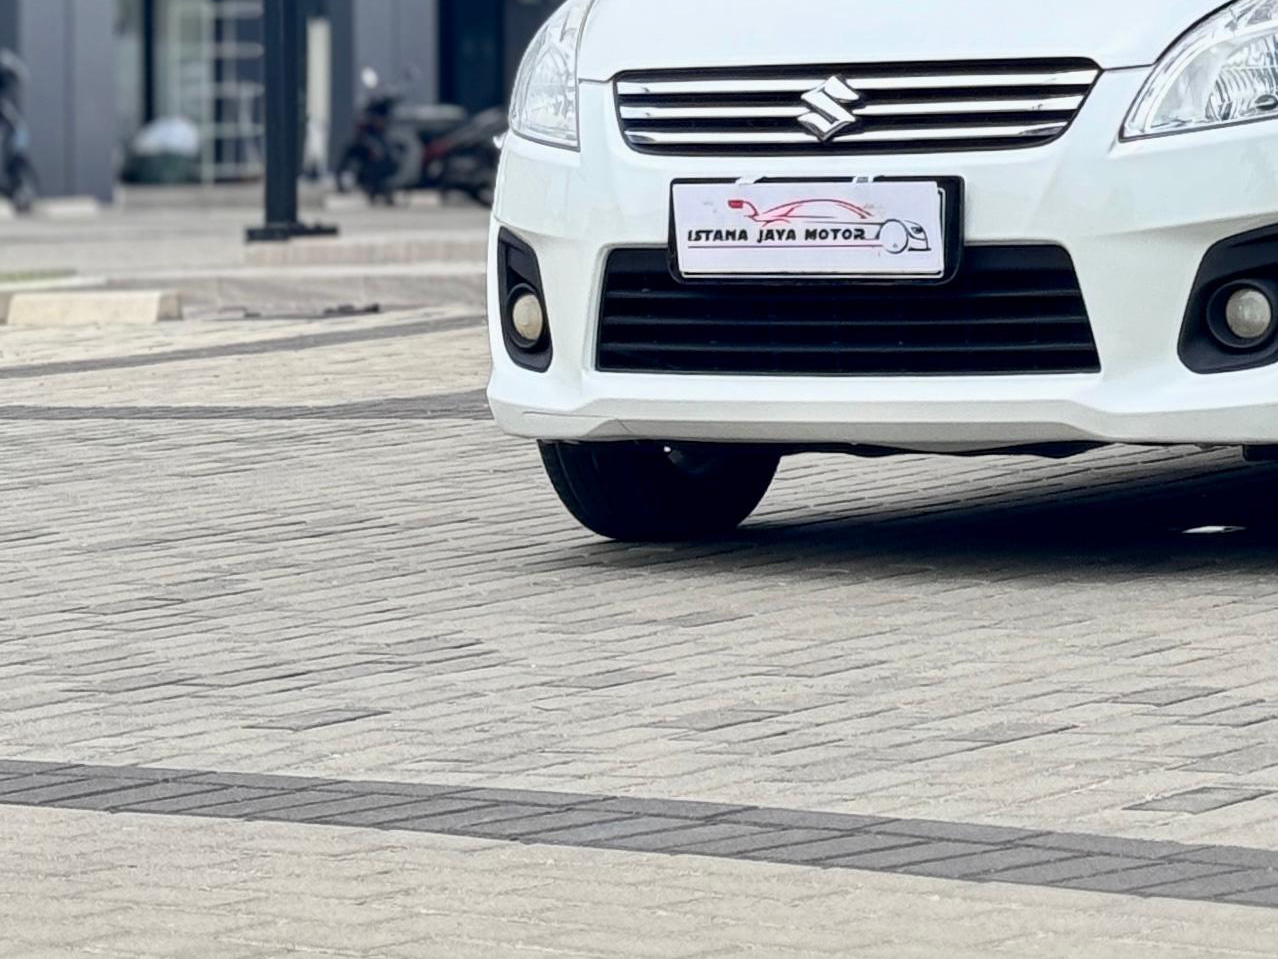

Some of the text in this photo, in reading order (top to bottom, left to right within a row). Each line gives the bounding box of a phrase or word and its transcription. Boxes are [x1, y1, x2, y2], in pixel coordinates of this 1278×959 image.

[687, 228, 866, 243] ISTANA JAYA MOTOR
